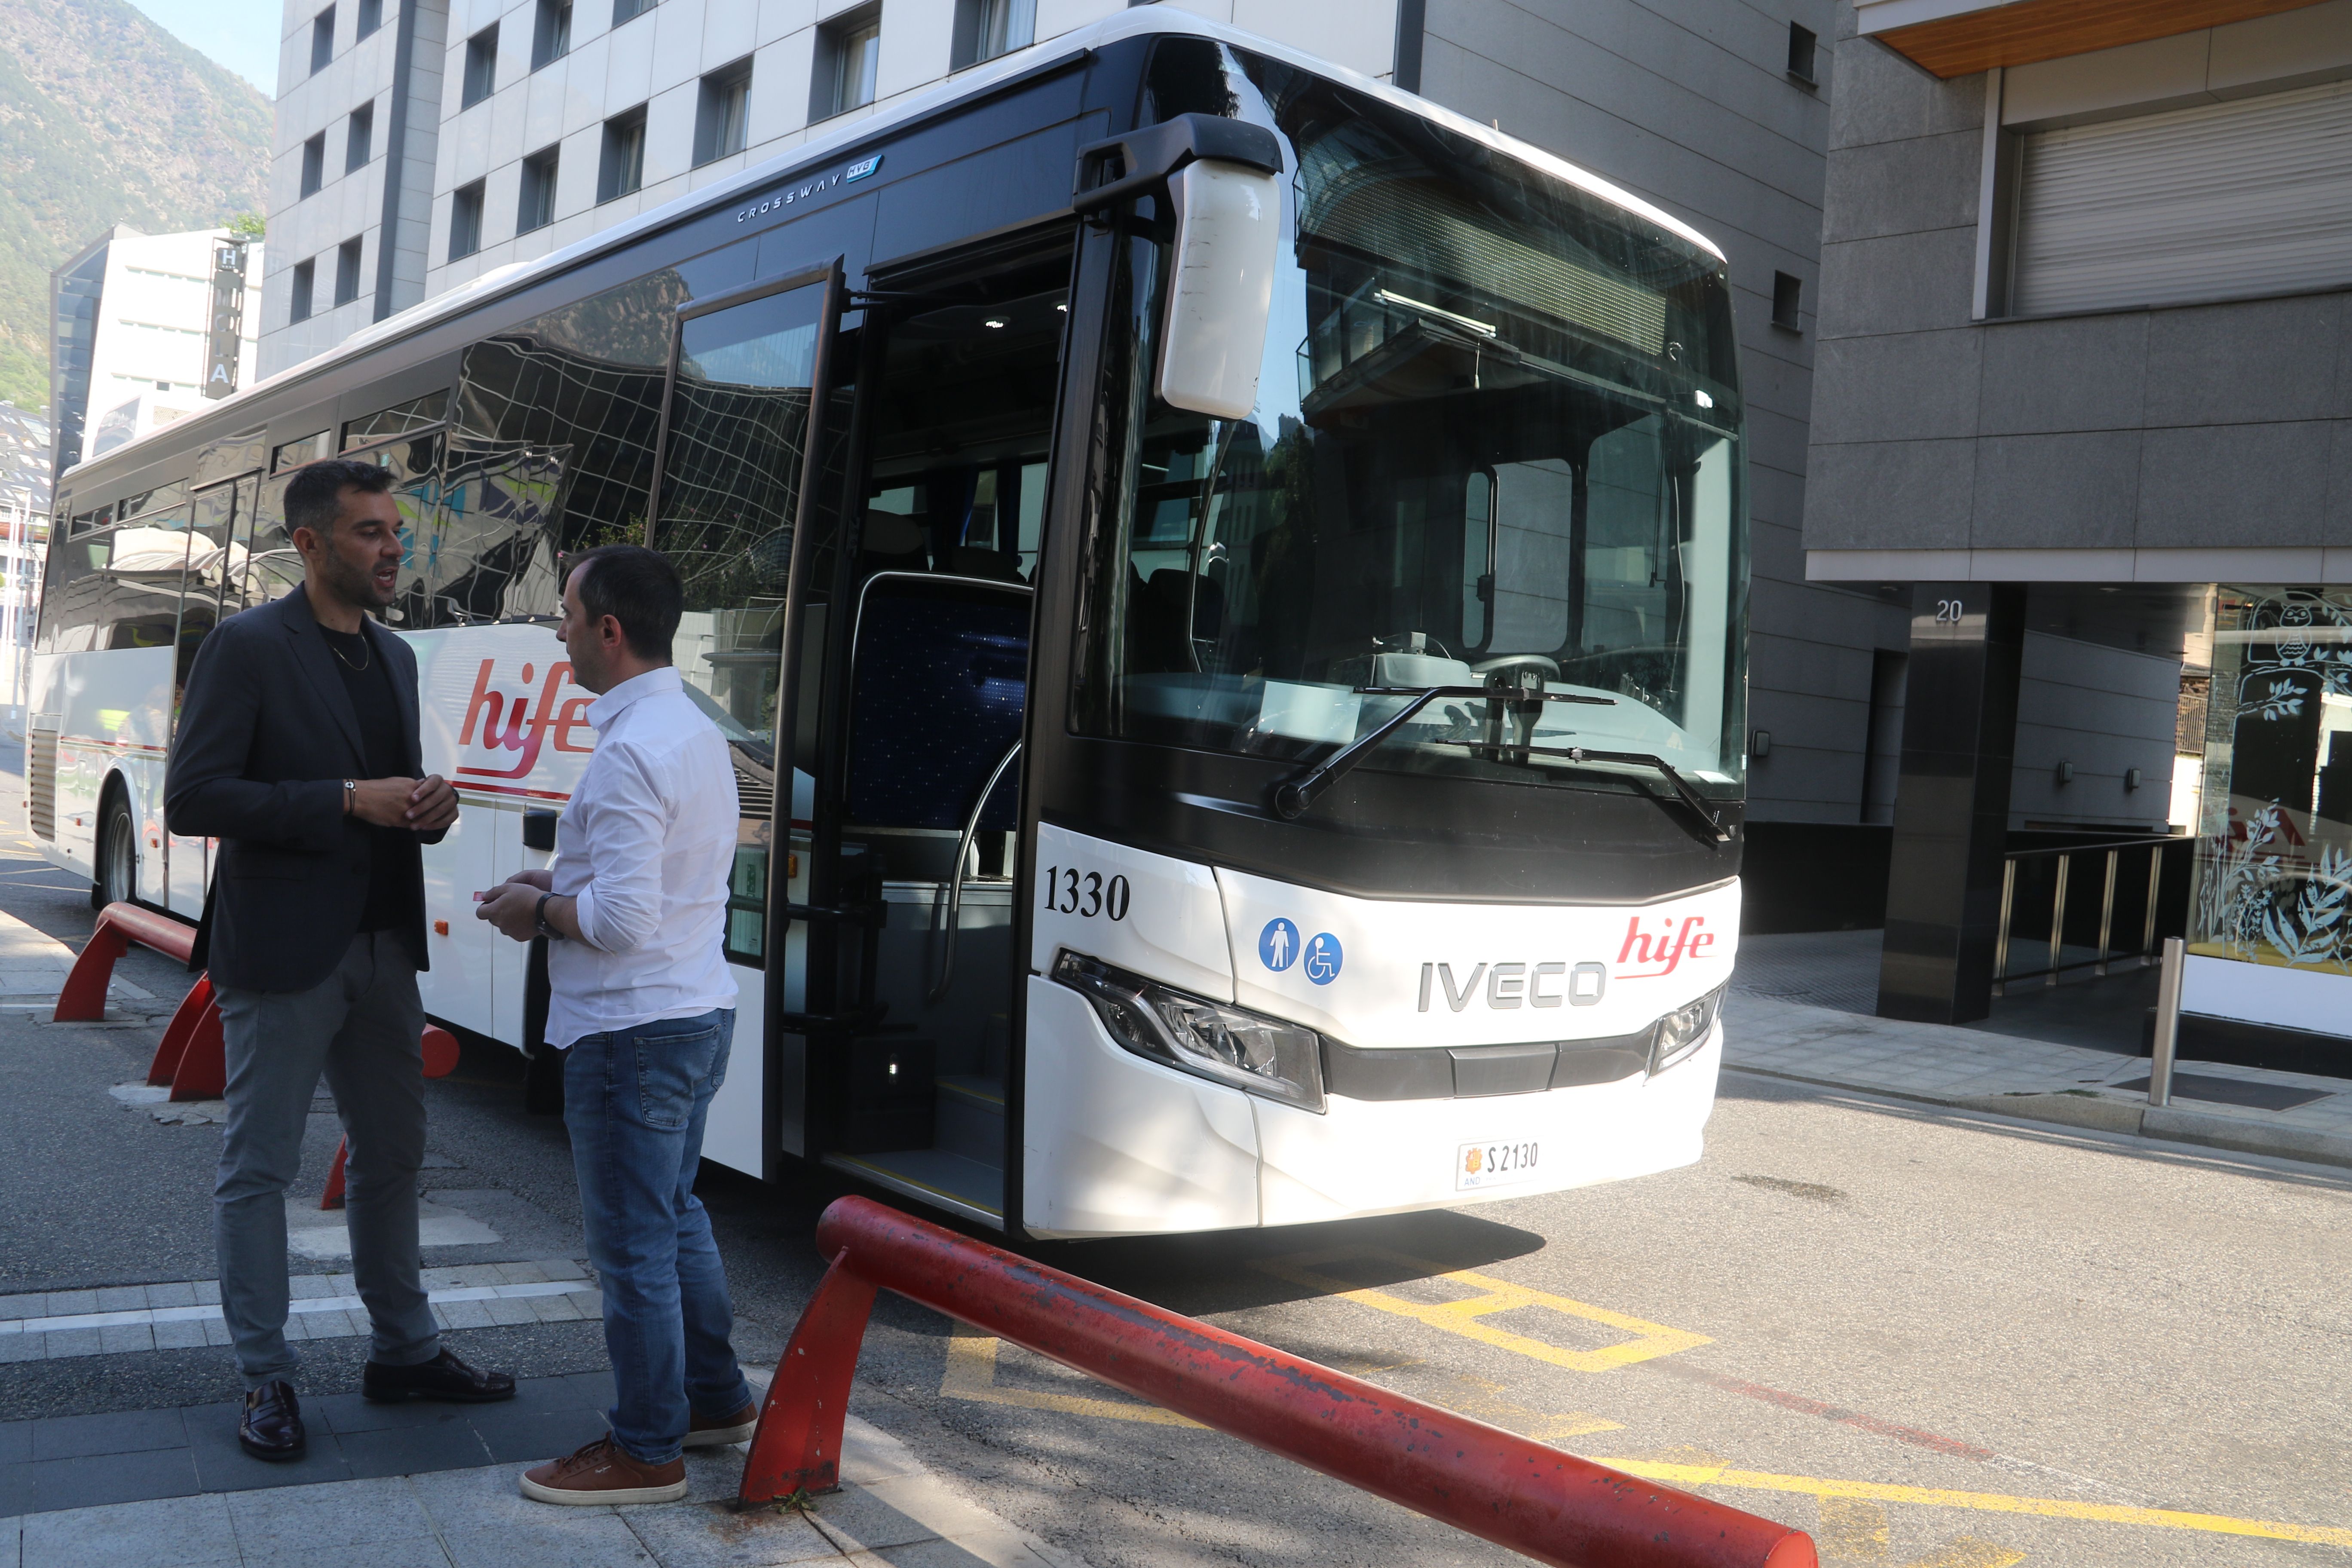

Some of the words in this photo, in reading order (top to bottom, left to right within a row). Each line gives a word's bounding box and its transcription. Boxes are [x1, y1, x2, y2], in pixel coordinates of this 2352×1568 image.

[737, 174, 841, 223] CROSSWAY
[848, 161, 870, 177] HYB
[222, 249, 236, 265] H
[1936, 600, 1963, 622] 20
[1044, 865, 1130, 921] 1330
[1614, 916, 1717, 979] hife
[1418, 962, 1607, 1012] IVECO
[1487, 1146, 1497, 1173] S
[1500, 1142, 1538, 1172] 2130
[1464, 1176, 1481, 1186] AND
